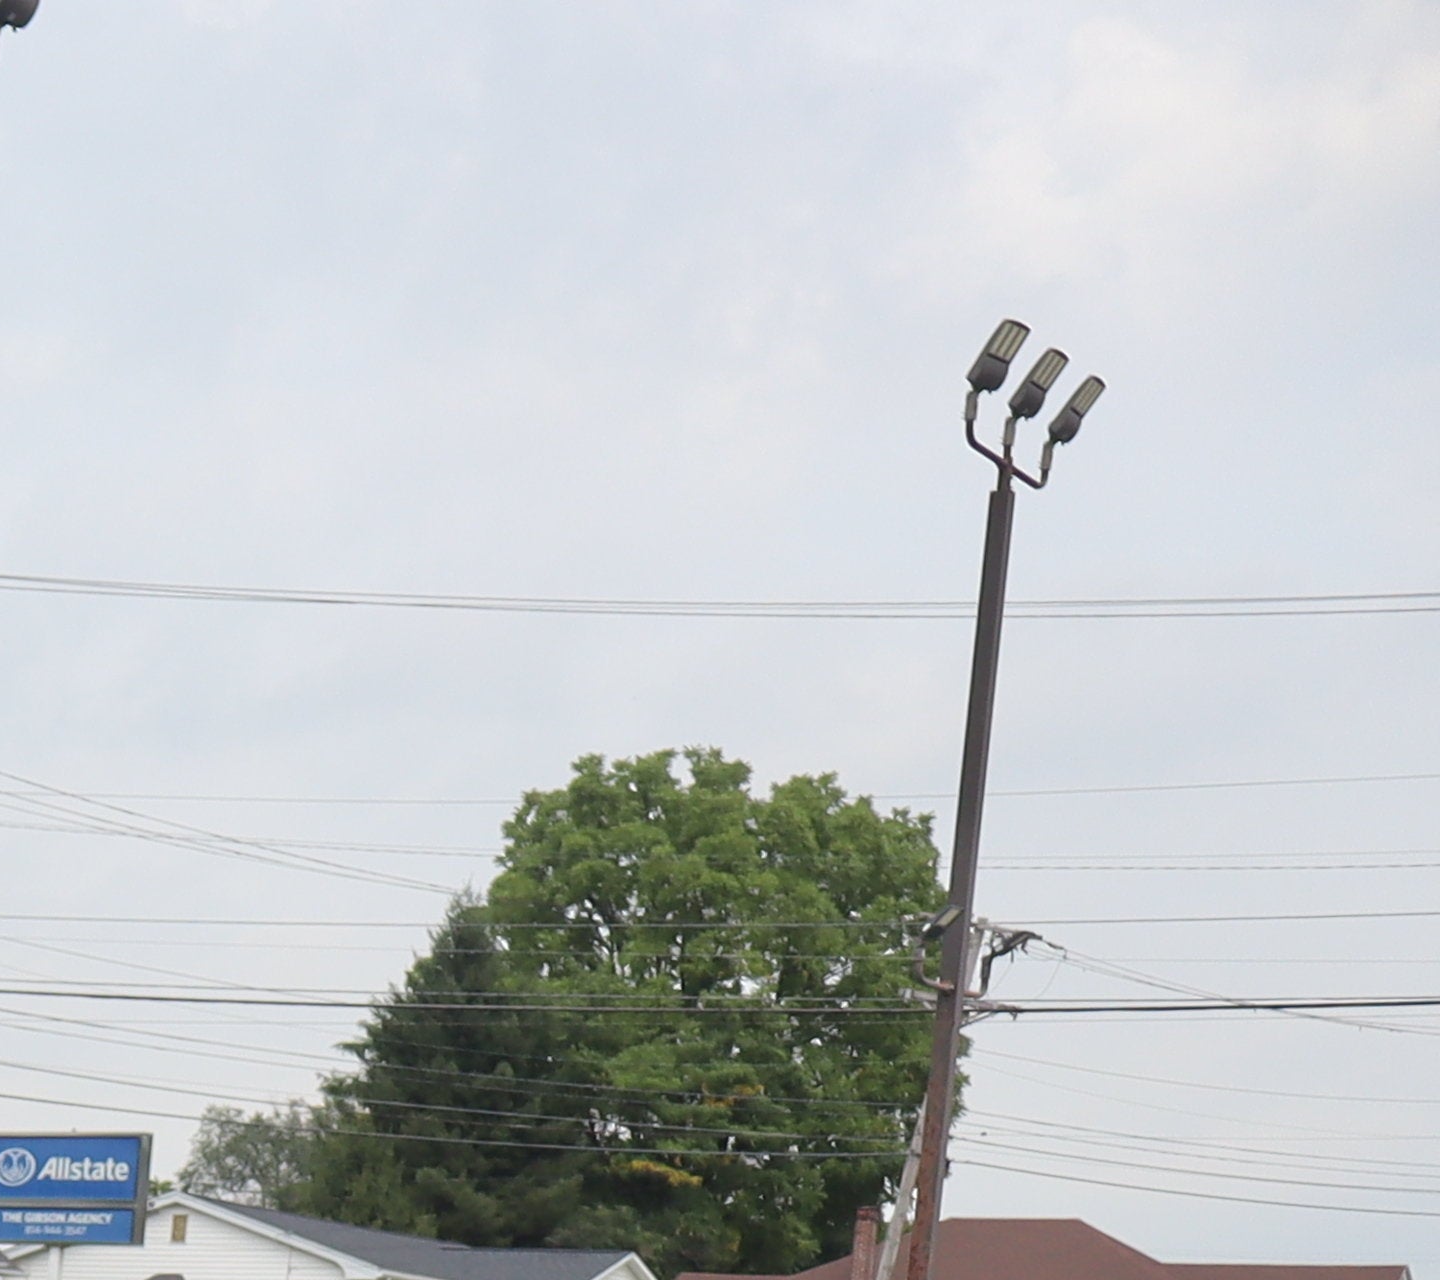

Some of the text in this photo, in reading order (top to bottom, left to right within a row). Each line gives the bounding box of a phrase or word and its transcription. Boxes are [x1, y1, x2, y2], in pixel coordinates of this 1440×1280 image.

[37, 1156, 129, 1182] Allstate
[2, 1211, 22, 1223] THE
[66, 1212, 113, 1225] AGENCY
